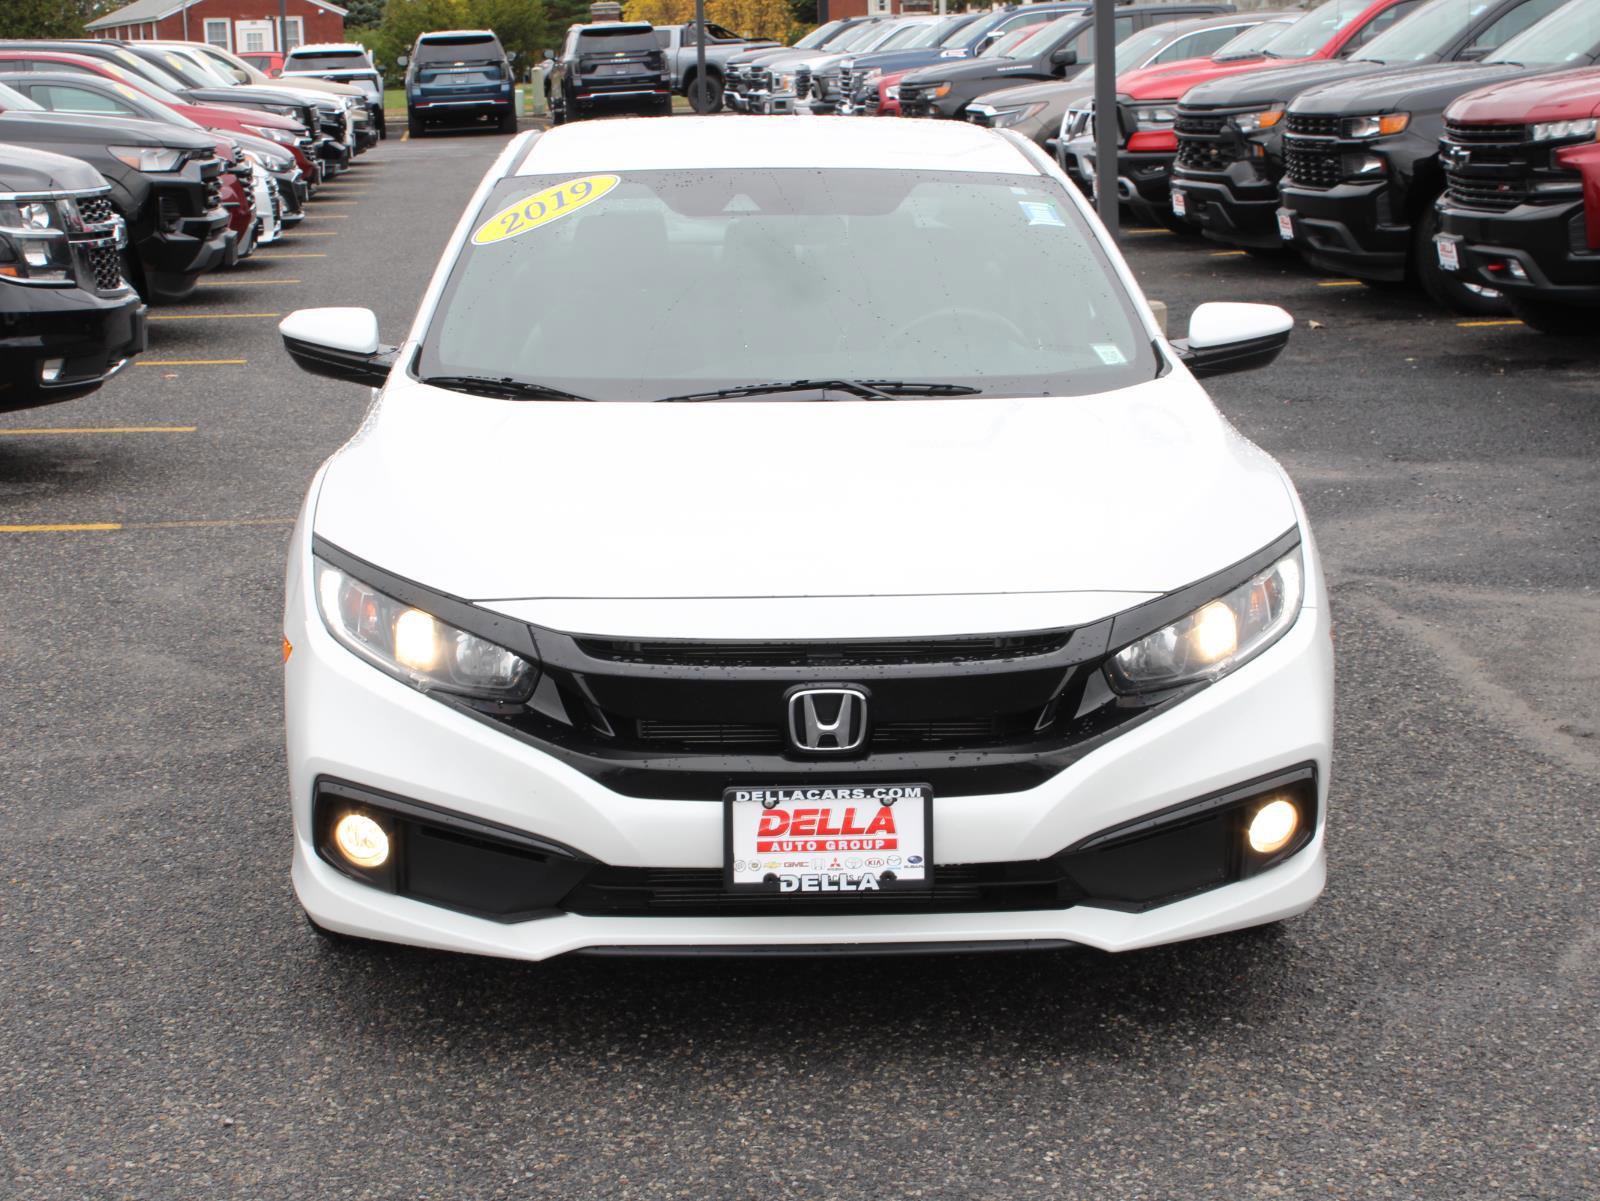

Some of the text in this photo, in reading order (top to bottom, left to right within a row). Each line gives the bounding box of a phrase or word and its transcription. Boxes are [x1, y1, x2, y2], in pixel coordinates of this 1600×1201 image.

[501, 181, 593, 234] 2019
[736, 787, 921, 802] DELLACARS.COM
[757, 806, 896, 837] DELLA
[771, 839, 885, 851] AUTO GROUP
[779, 873, 880, 892] DELLA
